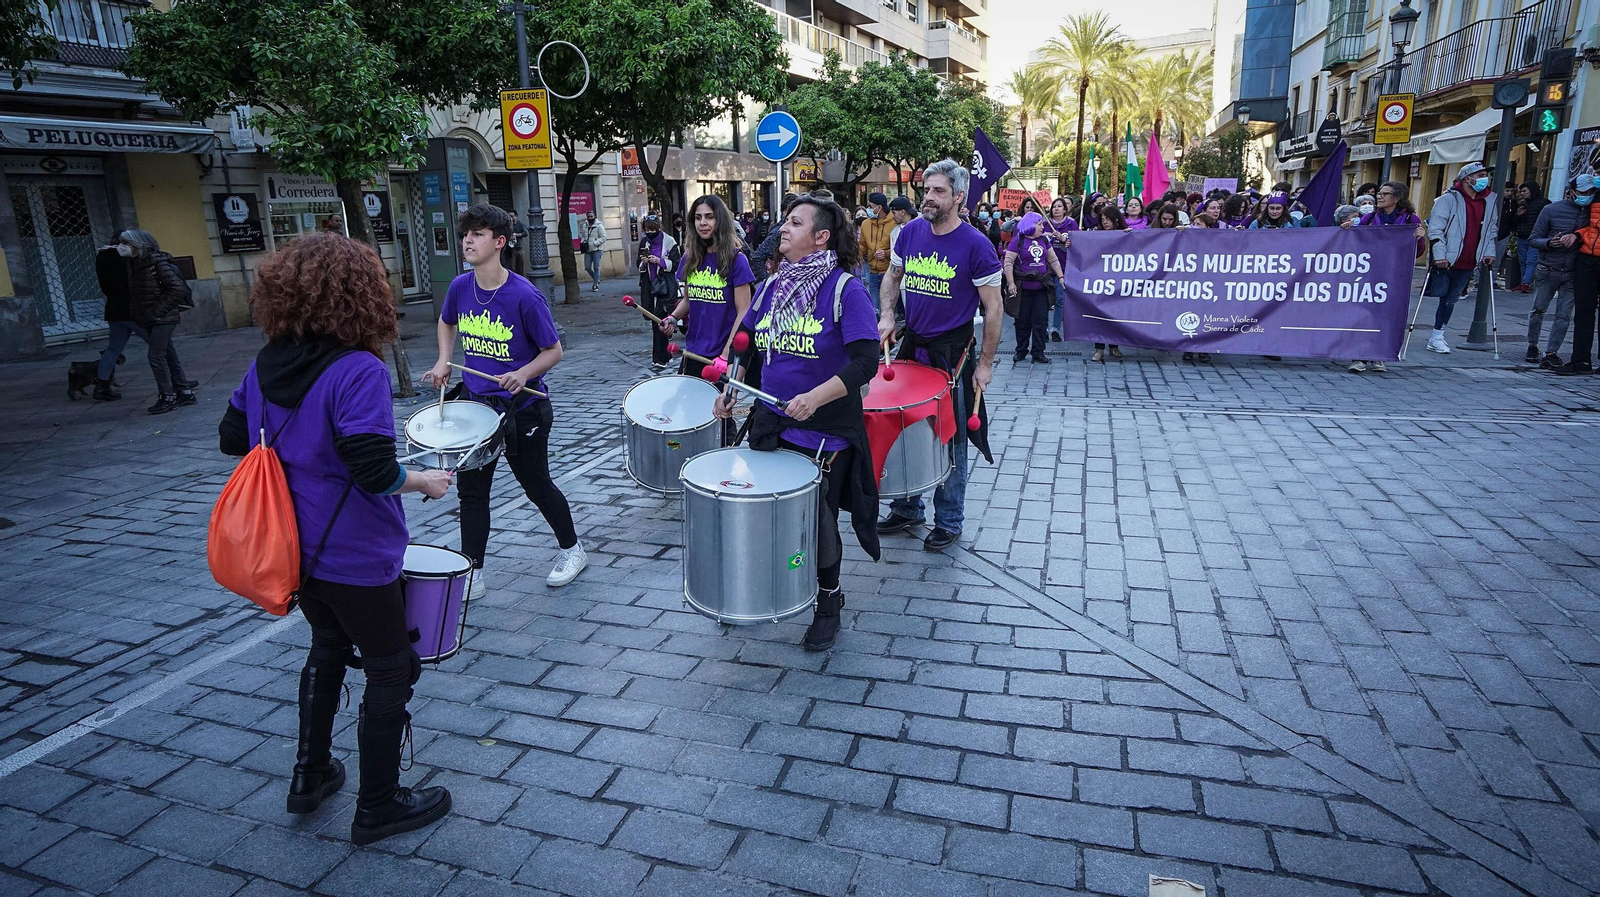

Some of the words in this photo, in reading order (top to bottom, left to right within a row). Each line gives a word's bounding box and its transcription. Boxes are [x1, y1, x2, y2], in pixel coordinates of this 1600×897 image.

[25, 128, 180, 148] PELUQUERIA
[278, 186, 334, 198] Corredera
[1102, 253, 1158, 272] TODAS
[1163, 253, 1197, 273] LAS
[1203, 254, 1296, 275] MUJERES,
[1303, 253, 1371, 274] TODOS
[1083, 279, 1115, 295] LOS
[1120, 279, 1218, 302] DERECHOS,
[1225, 282, 1287, 302] TODOS
[1293, 282, 1331, 302] LOS
[1338, 277, 1388, 303] DÍAS
[1204, 314, 1228, 322] Marea
[1230, 315, 1258, 323] Violeta
[1203, 324, 1228, 332] Sierra
[1241, 325, 1264, 333] Cádiz
